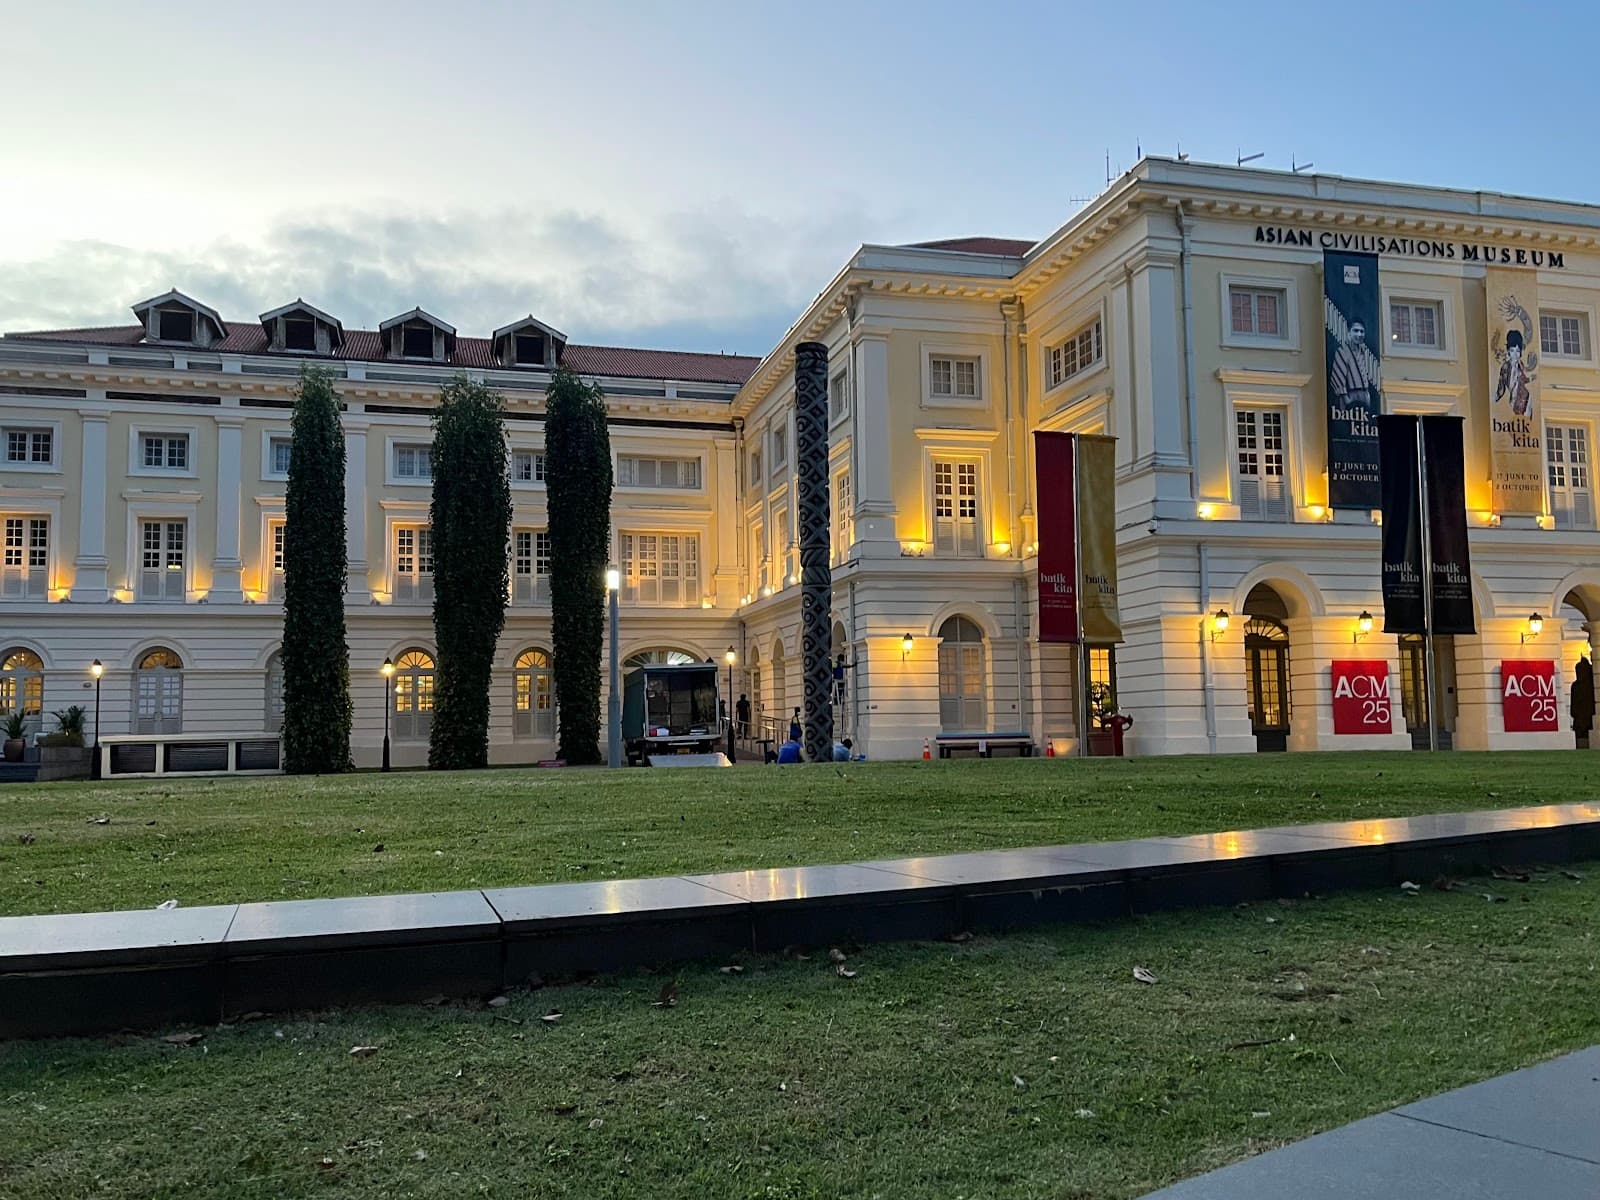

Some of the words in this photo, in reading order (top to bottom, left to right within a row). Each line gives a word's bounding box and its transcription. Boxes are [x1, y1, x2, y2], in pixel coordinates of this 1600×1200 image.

[1255, 226, 1313, 246] ASIAN
[1319, 232, 1455, 259] CIVILISATIONS
[1462, 244, 1565, 268] MUSEUM
[1331, 405, 1369, 421] batik
[1351, 421, 1379, 437] kita
[1492, 418, 1530, 433] batik
[1513, 433, 1540, 448] kita
[1342, 462, 1365, 472] JUNE
[1367, 463, 1378, 471] TO
[1340, 473, 1380, 482] OCTOBER
[1504, 473, 1526, 482] JUNE
[1384, 561, 1413, 572] batik
[1432, 562, 1460, 574] batik
[1040, 572, 1067, 583] batik
[1085, 574, 1109, 585] batik
[1400, 571, 1420, 583] kita
[1447, 573, 1468, 583] kita
[1053, 583, 1073, 593] kita
[1334, 675, 1391, 698] ACM
[1504, 674, 1557, 697] ACM
[1362, 700, 1390, 724] 25
[1530, 698, 1557, 721] 25
